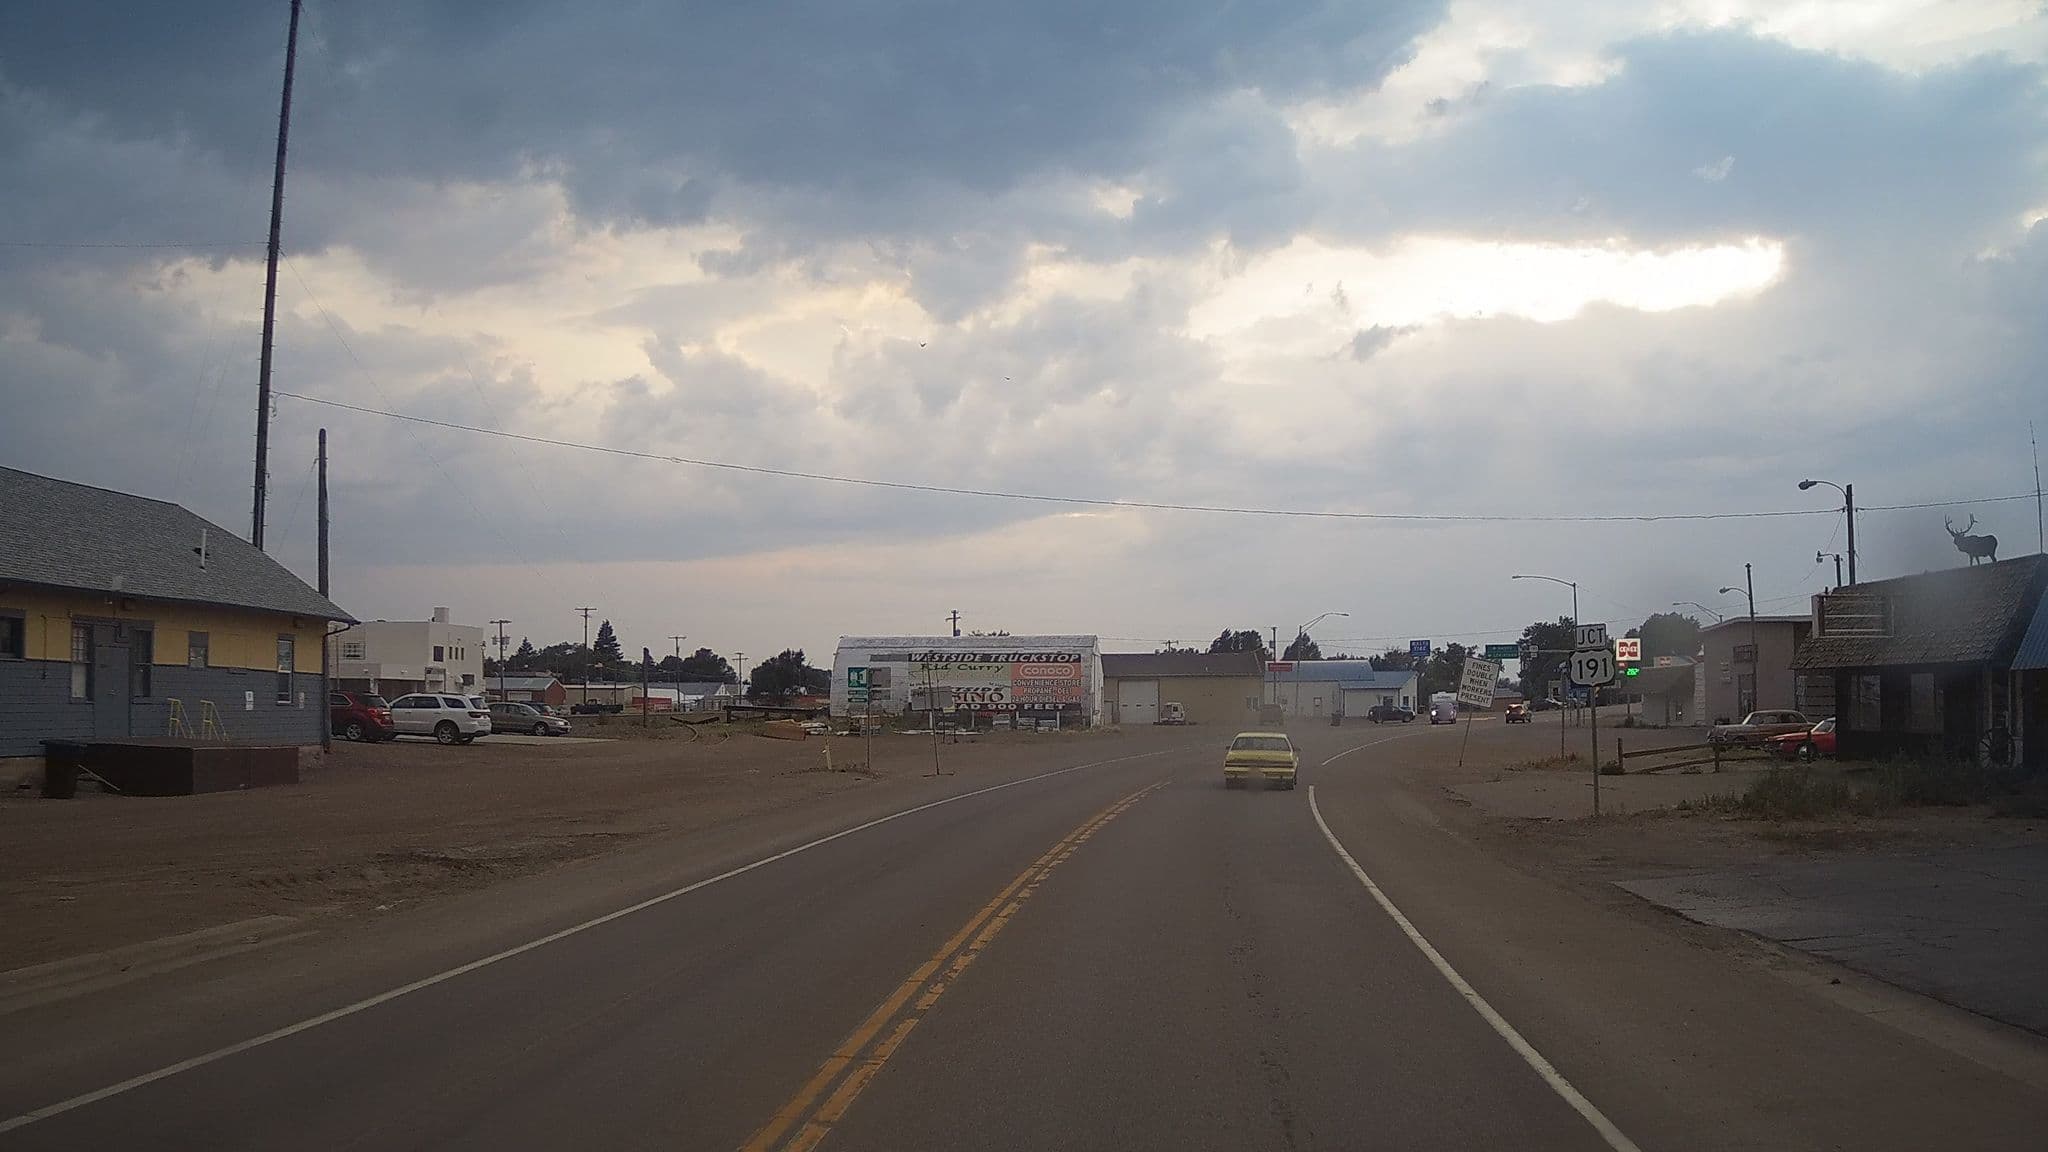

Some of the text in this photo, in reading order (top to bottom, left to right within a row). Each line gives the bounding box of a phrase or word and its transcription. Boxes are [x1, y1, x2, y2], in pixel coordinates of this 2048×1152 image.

[1578, 628, 1603, 645] JCT
[911, 653, 1079, 662] WESTSIDE TRUCKSTOP
[957, 663, 1004, 673] Curry
[1472, 662, 1491, 672] FINES
[1577, 657, 1608, 679] 191
[1466, 669, 1494, 681] DOUBLE
[1469, 678, 1489, 687] WHEN
[1462, 684, 1492, 696] WORKERS
[1461, 692, 1490, 704] PRESENT
